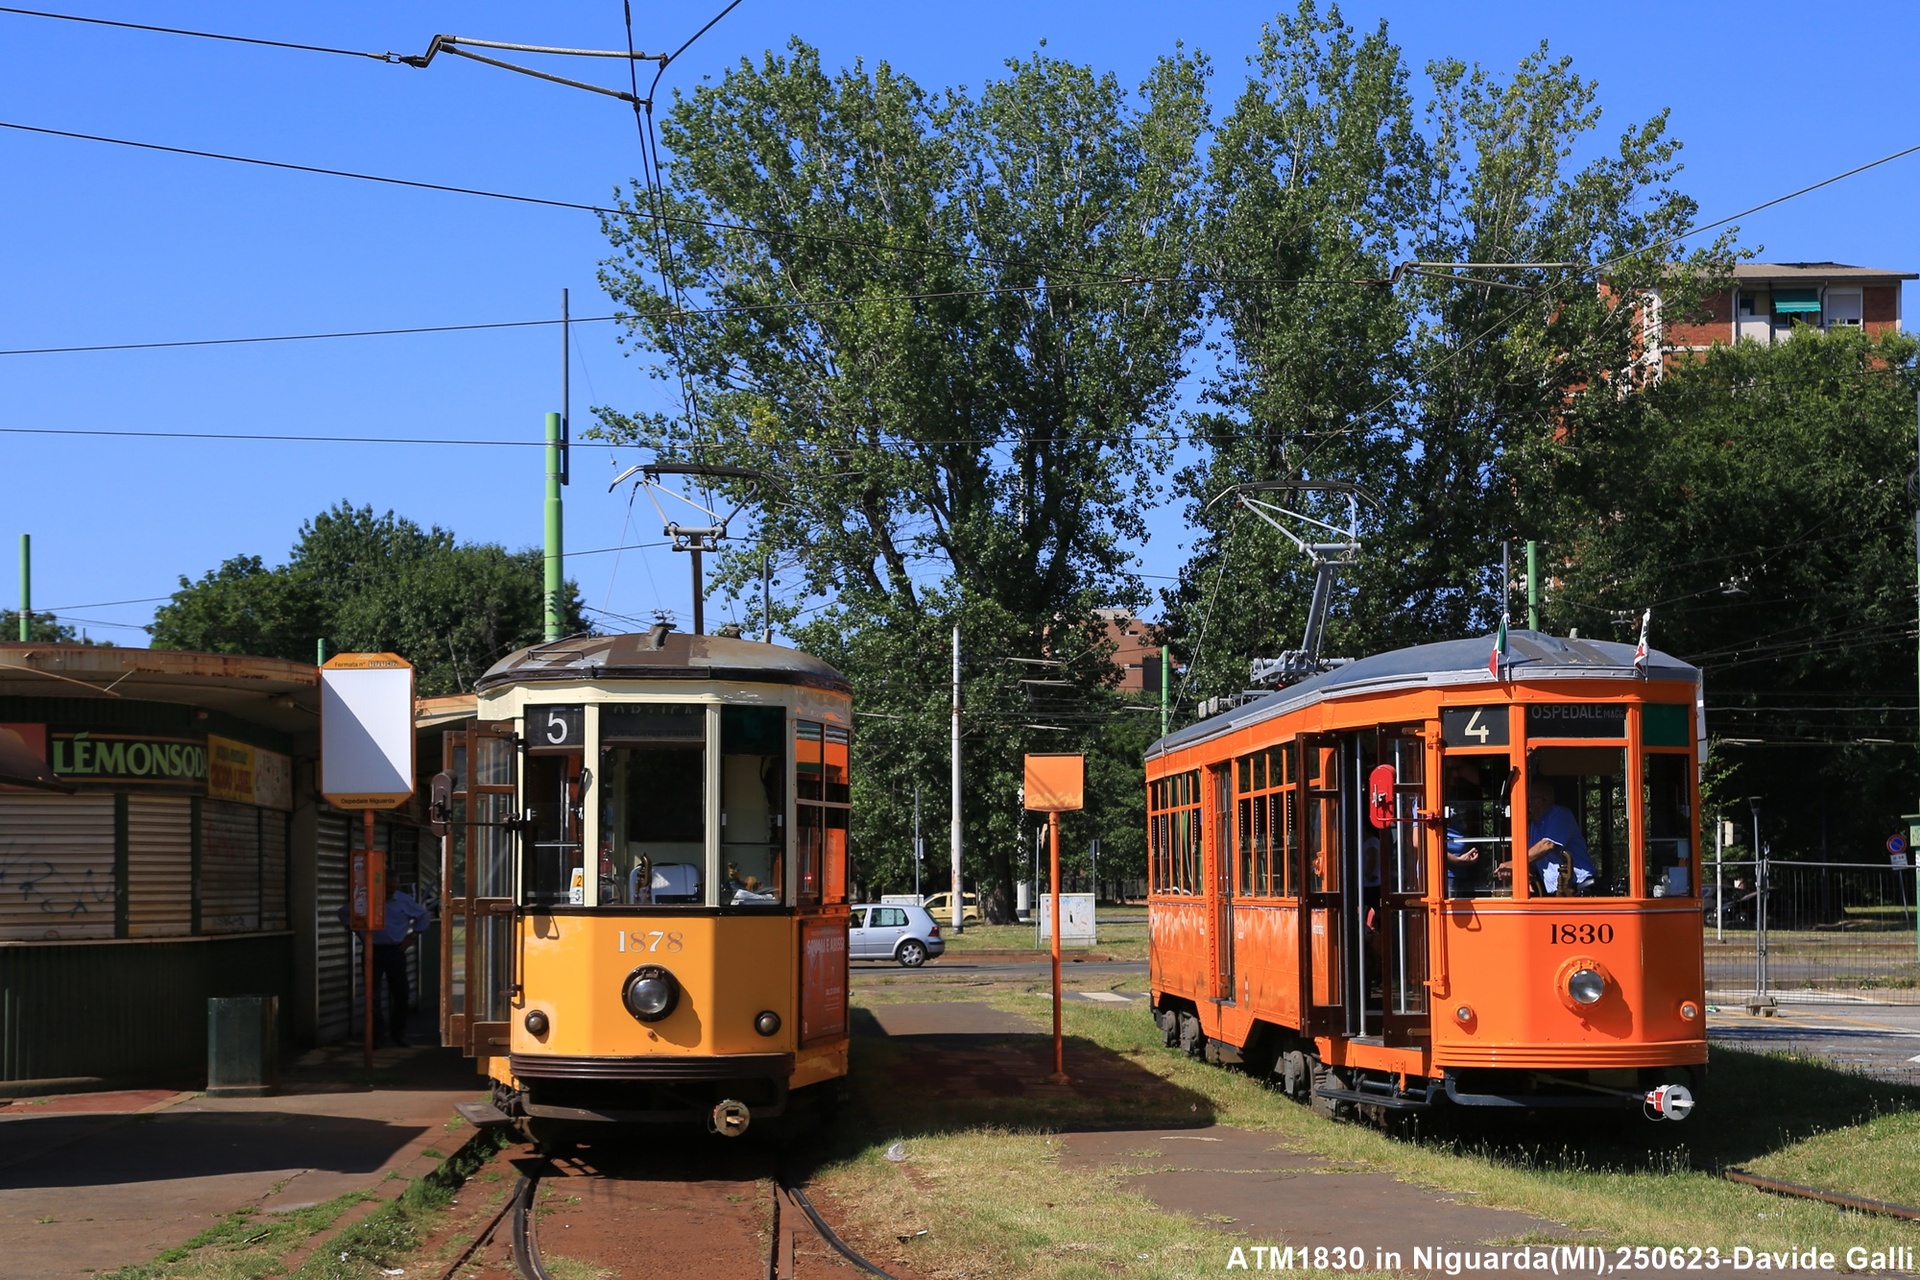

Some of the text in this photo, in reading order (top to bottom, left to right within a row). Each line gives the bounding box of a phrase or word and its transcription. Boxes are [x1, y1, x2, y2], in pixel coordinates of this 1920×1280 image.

[1531, 705, 1603, 720] OSPEDALE
[547, 707, 568, 744] 5
[1464, 706, 1490, 744] 4
[340, 797, 396, 805] Ospedale Niguarda
[618, 930, 684, 953] 1878
[1550, 923, 1614, 945] 1830
